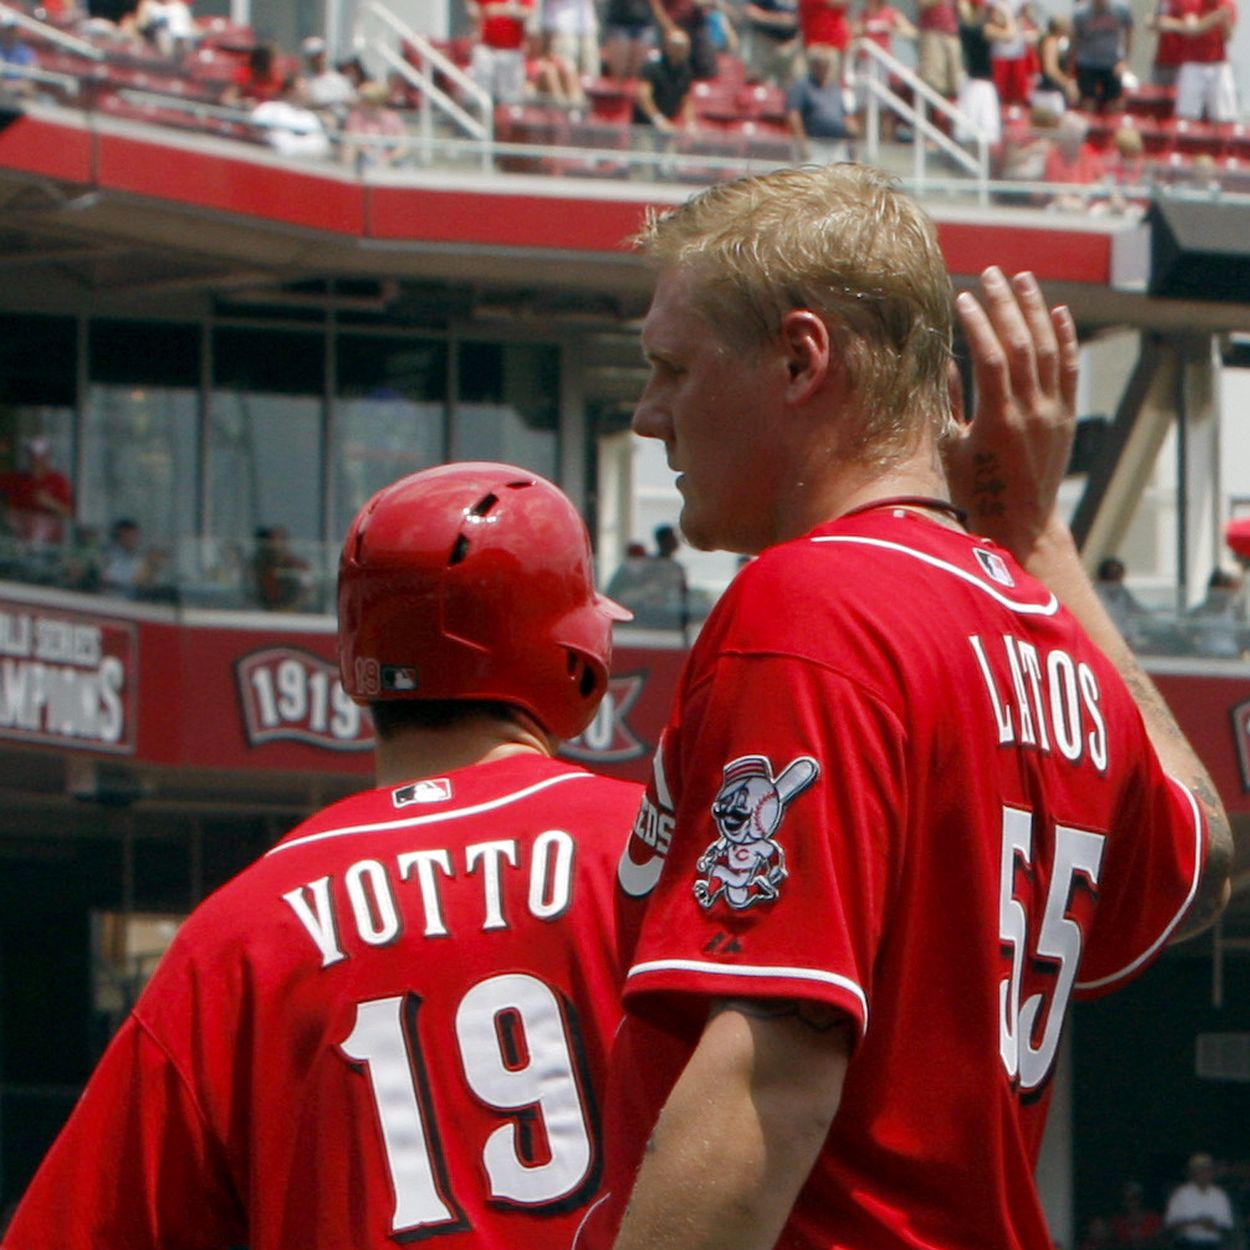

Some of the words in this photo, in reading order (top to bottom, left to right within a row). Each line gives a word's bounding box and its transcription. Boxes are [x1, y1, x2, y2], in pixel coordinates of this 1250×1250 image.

[968, 634, 1108, 773] LATOS
[281, 829, 577, 968] VOTTO
[1000, 803, 1106, 1098] 55
[336, 972, 604, 1240] 19
